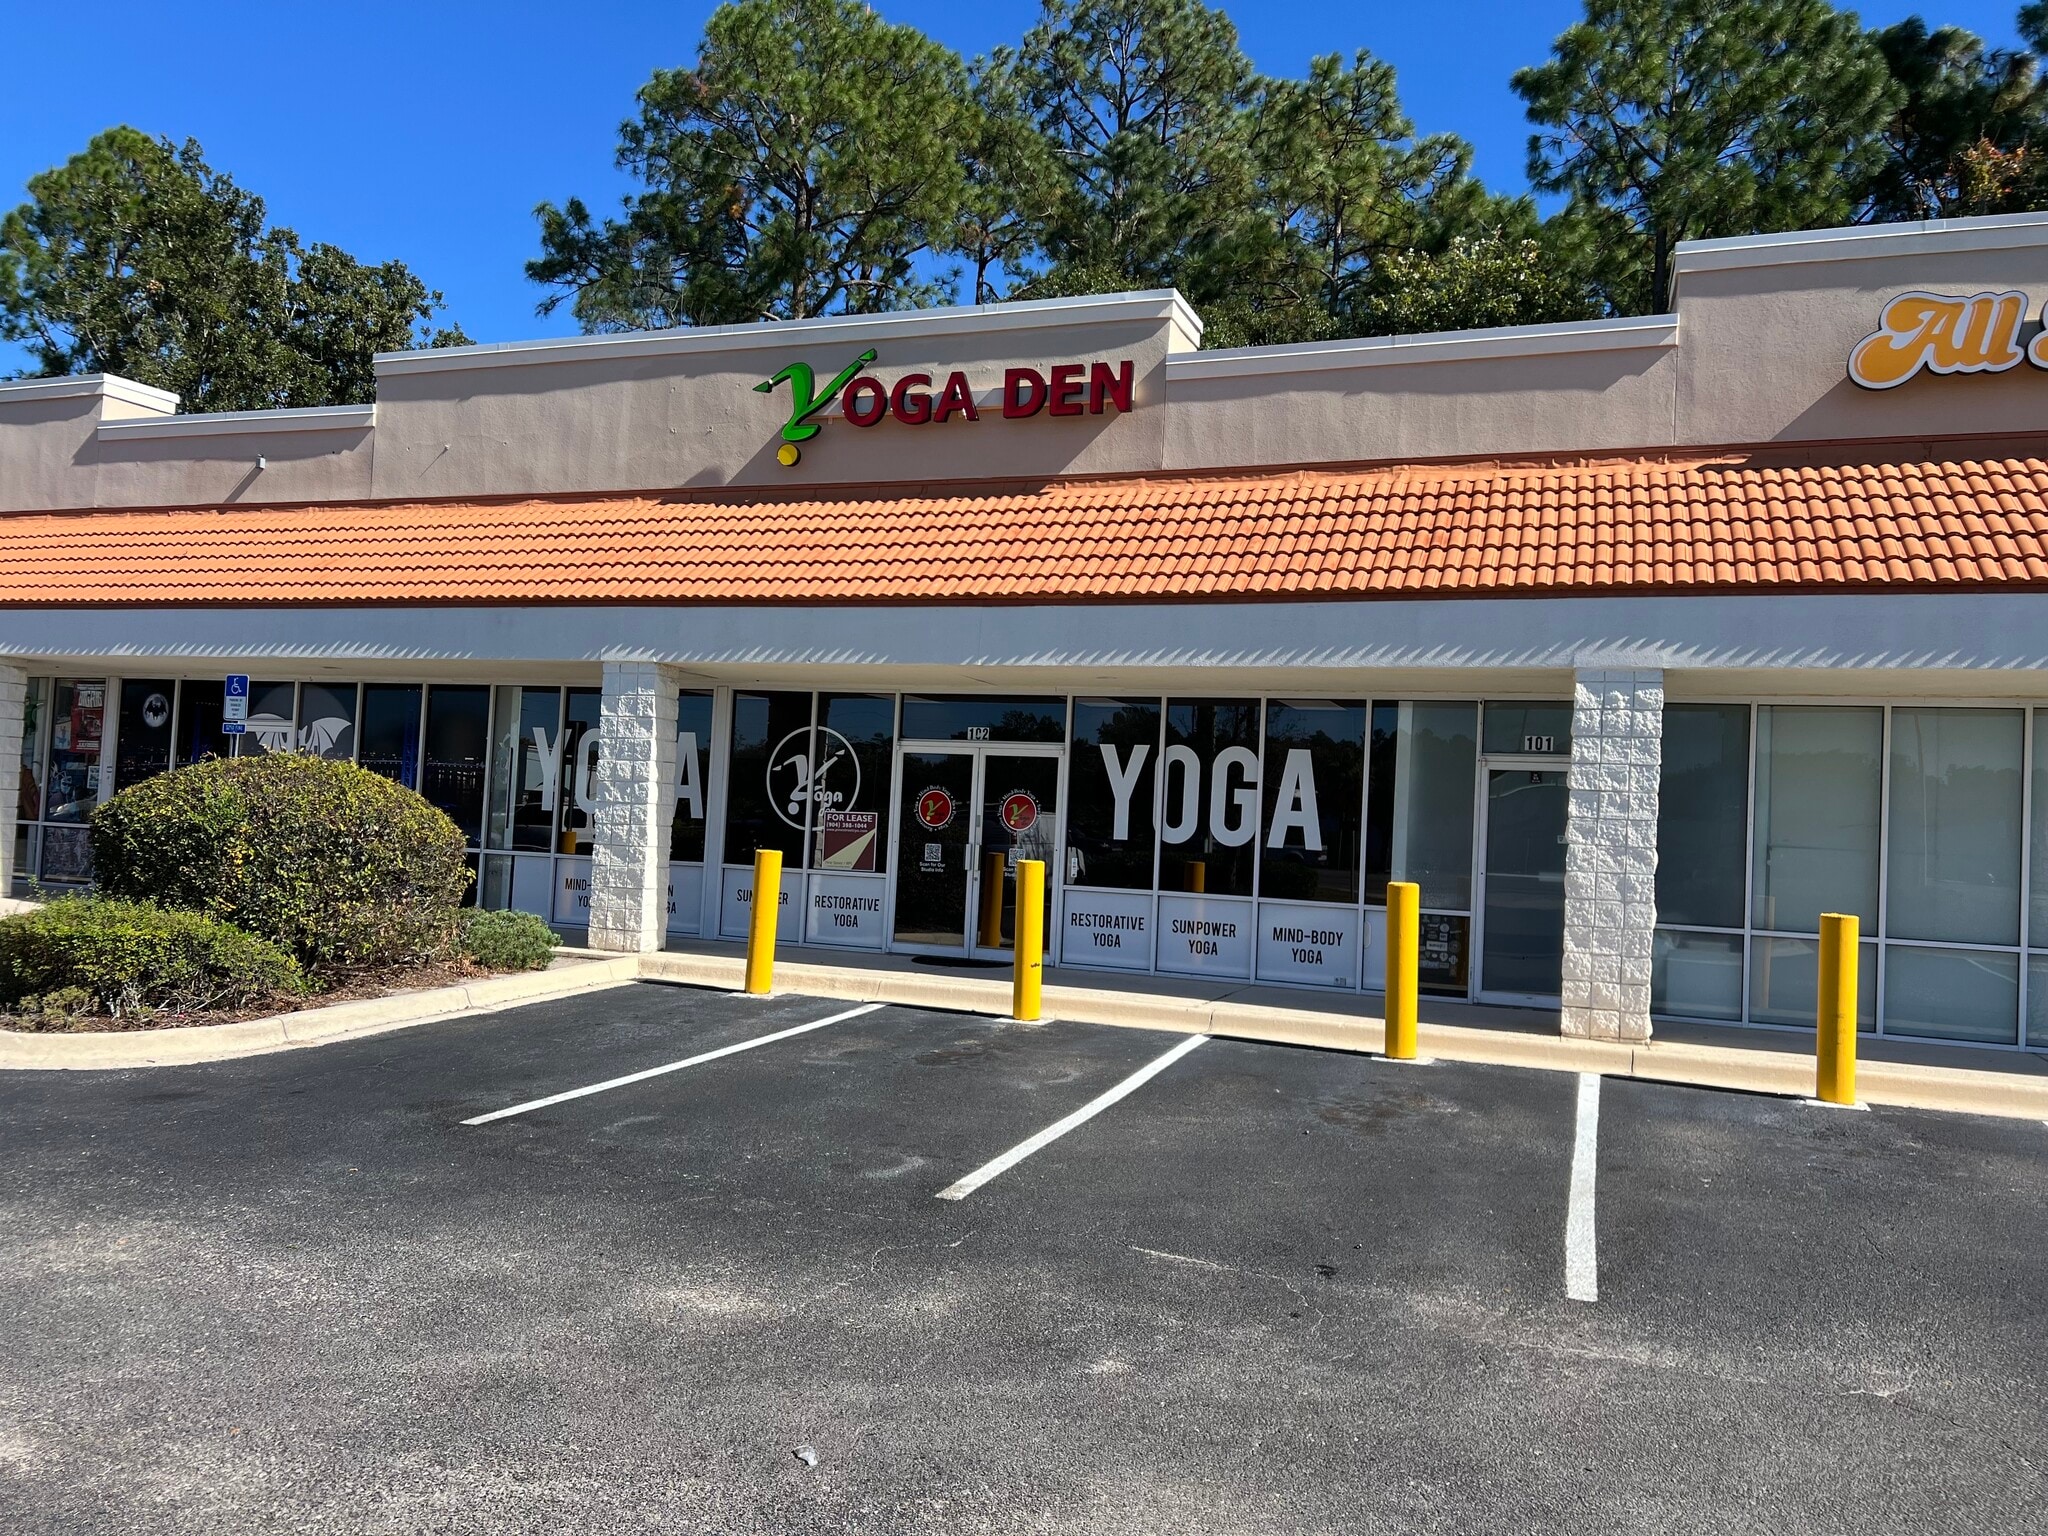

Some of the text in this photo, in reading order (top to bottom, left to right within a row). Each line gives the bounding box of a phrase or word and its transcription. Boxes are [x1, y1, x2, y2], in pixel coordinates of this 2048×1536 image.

[1848, 291, 2028, 389] All
[752, 348, 1134, 445] YOGA DEN
[970, 728, 988, 740] 102
[1526, 736, 1552, 750] 101
[532, 727, 703, 819] YOA
[1099, 744, 1322, 851] YOGA
[846, 814, 872, 822] LEASE
[814, 895, 880, 912] RESTORATIVE
[834, 914, 858, 928] YOGA
[1071, 912, 1144, 931] RESTORATIVE
[1172, 920, 1236, 938] SUNPOWER
[1093, 932, 1121, 948] YOGA
[1272, 926, 1344, 946] MIND-BODY
[1188, 940, 1218, 956] YOGA
[1292, 948, 1322, 965] YOGA
